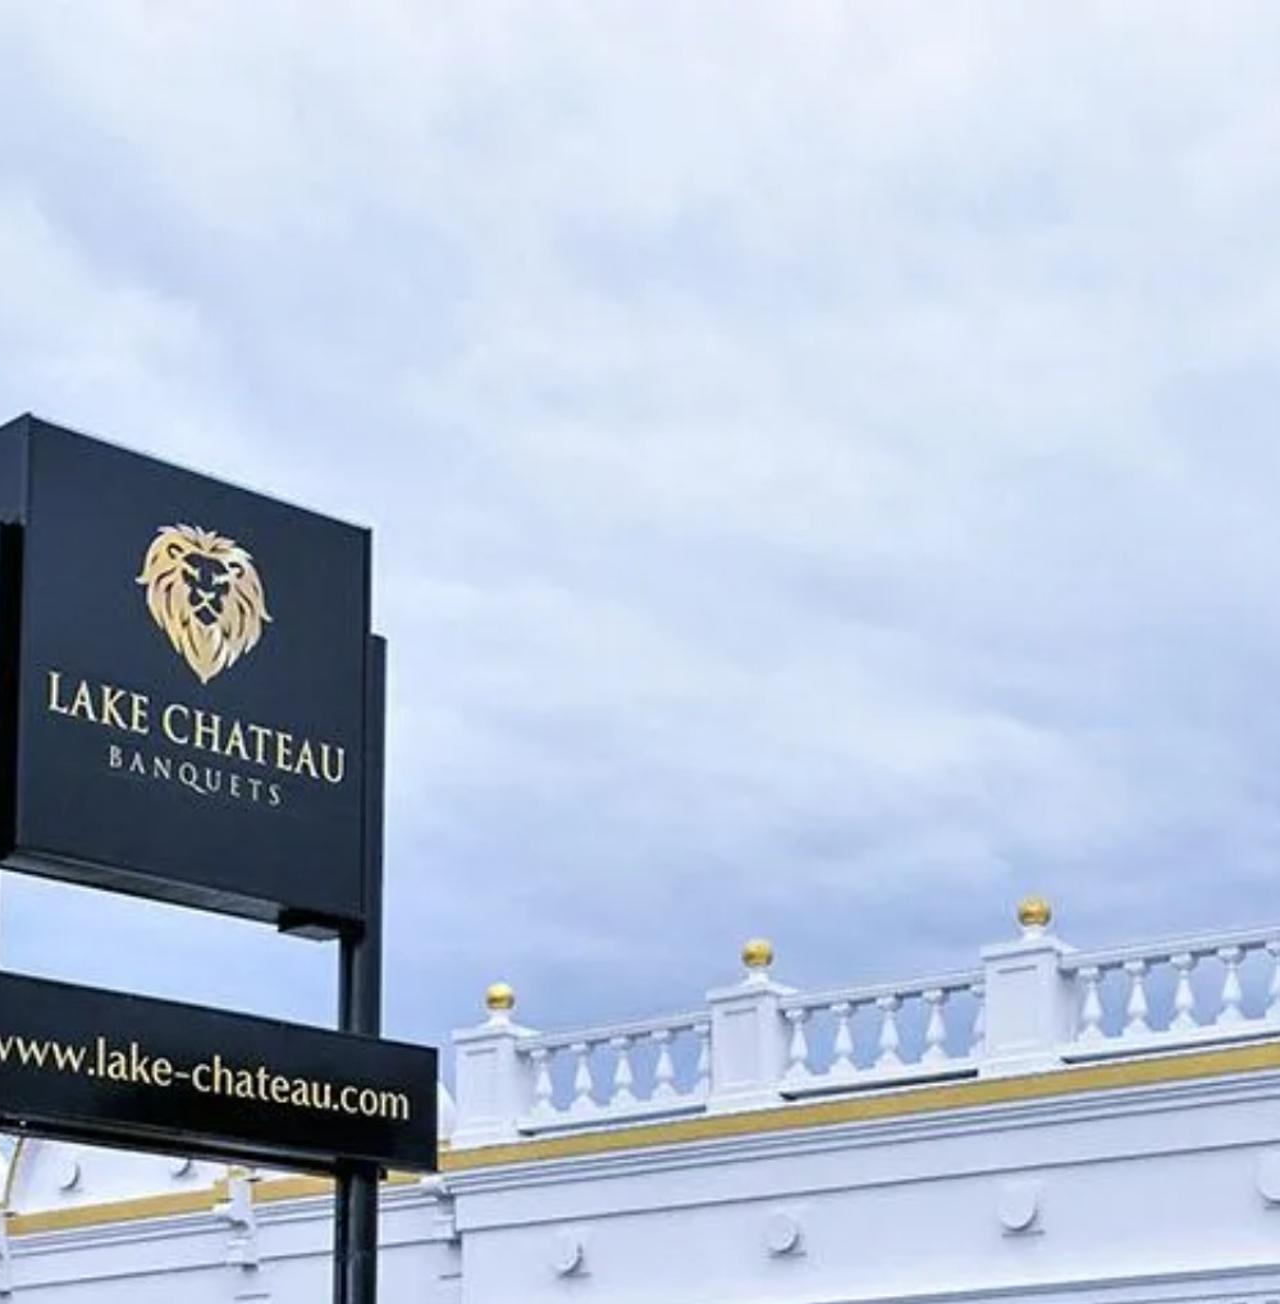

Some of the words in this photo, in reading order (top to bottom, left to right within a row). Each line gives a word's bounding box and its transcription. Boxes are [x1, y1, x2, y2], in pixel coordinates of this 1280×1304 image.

[48, 671, 150, 735] LAKE
[163, 704, 345, 783] CHATEAU
[110, 746, 282, 807] BANQUETS
